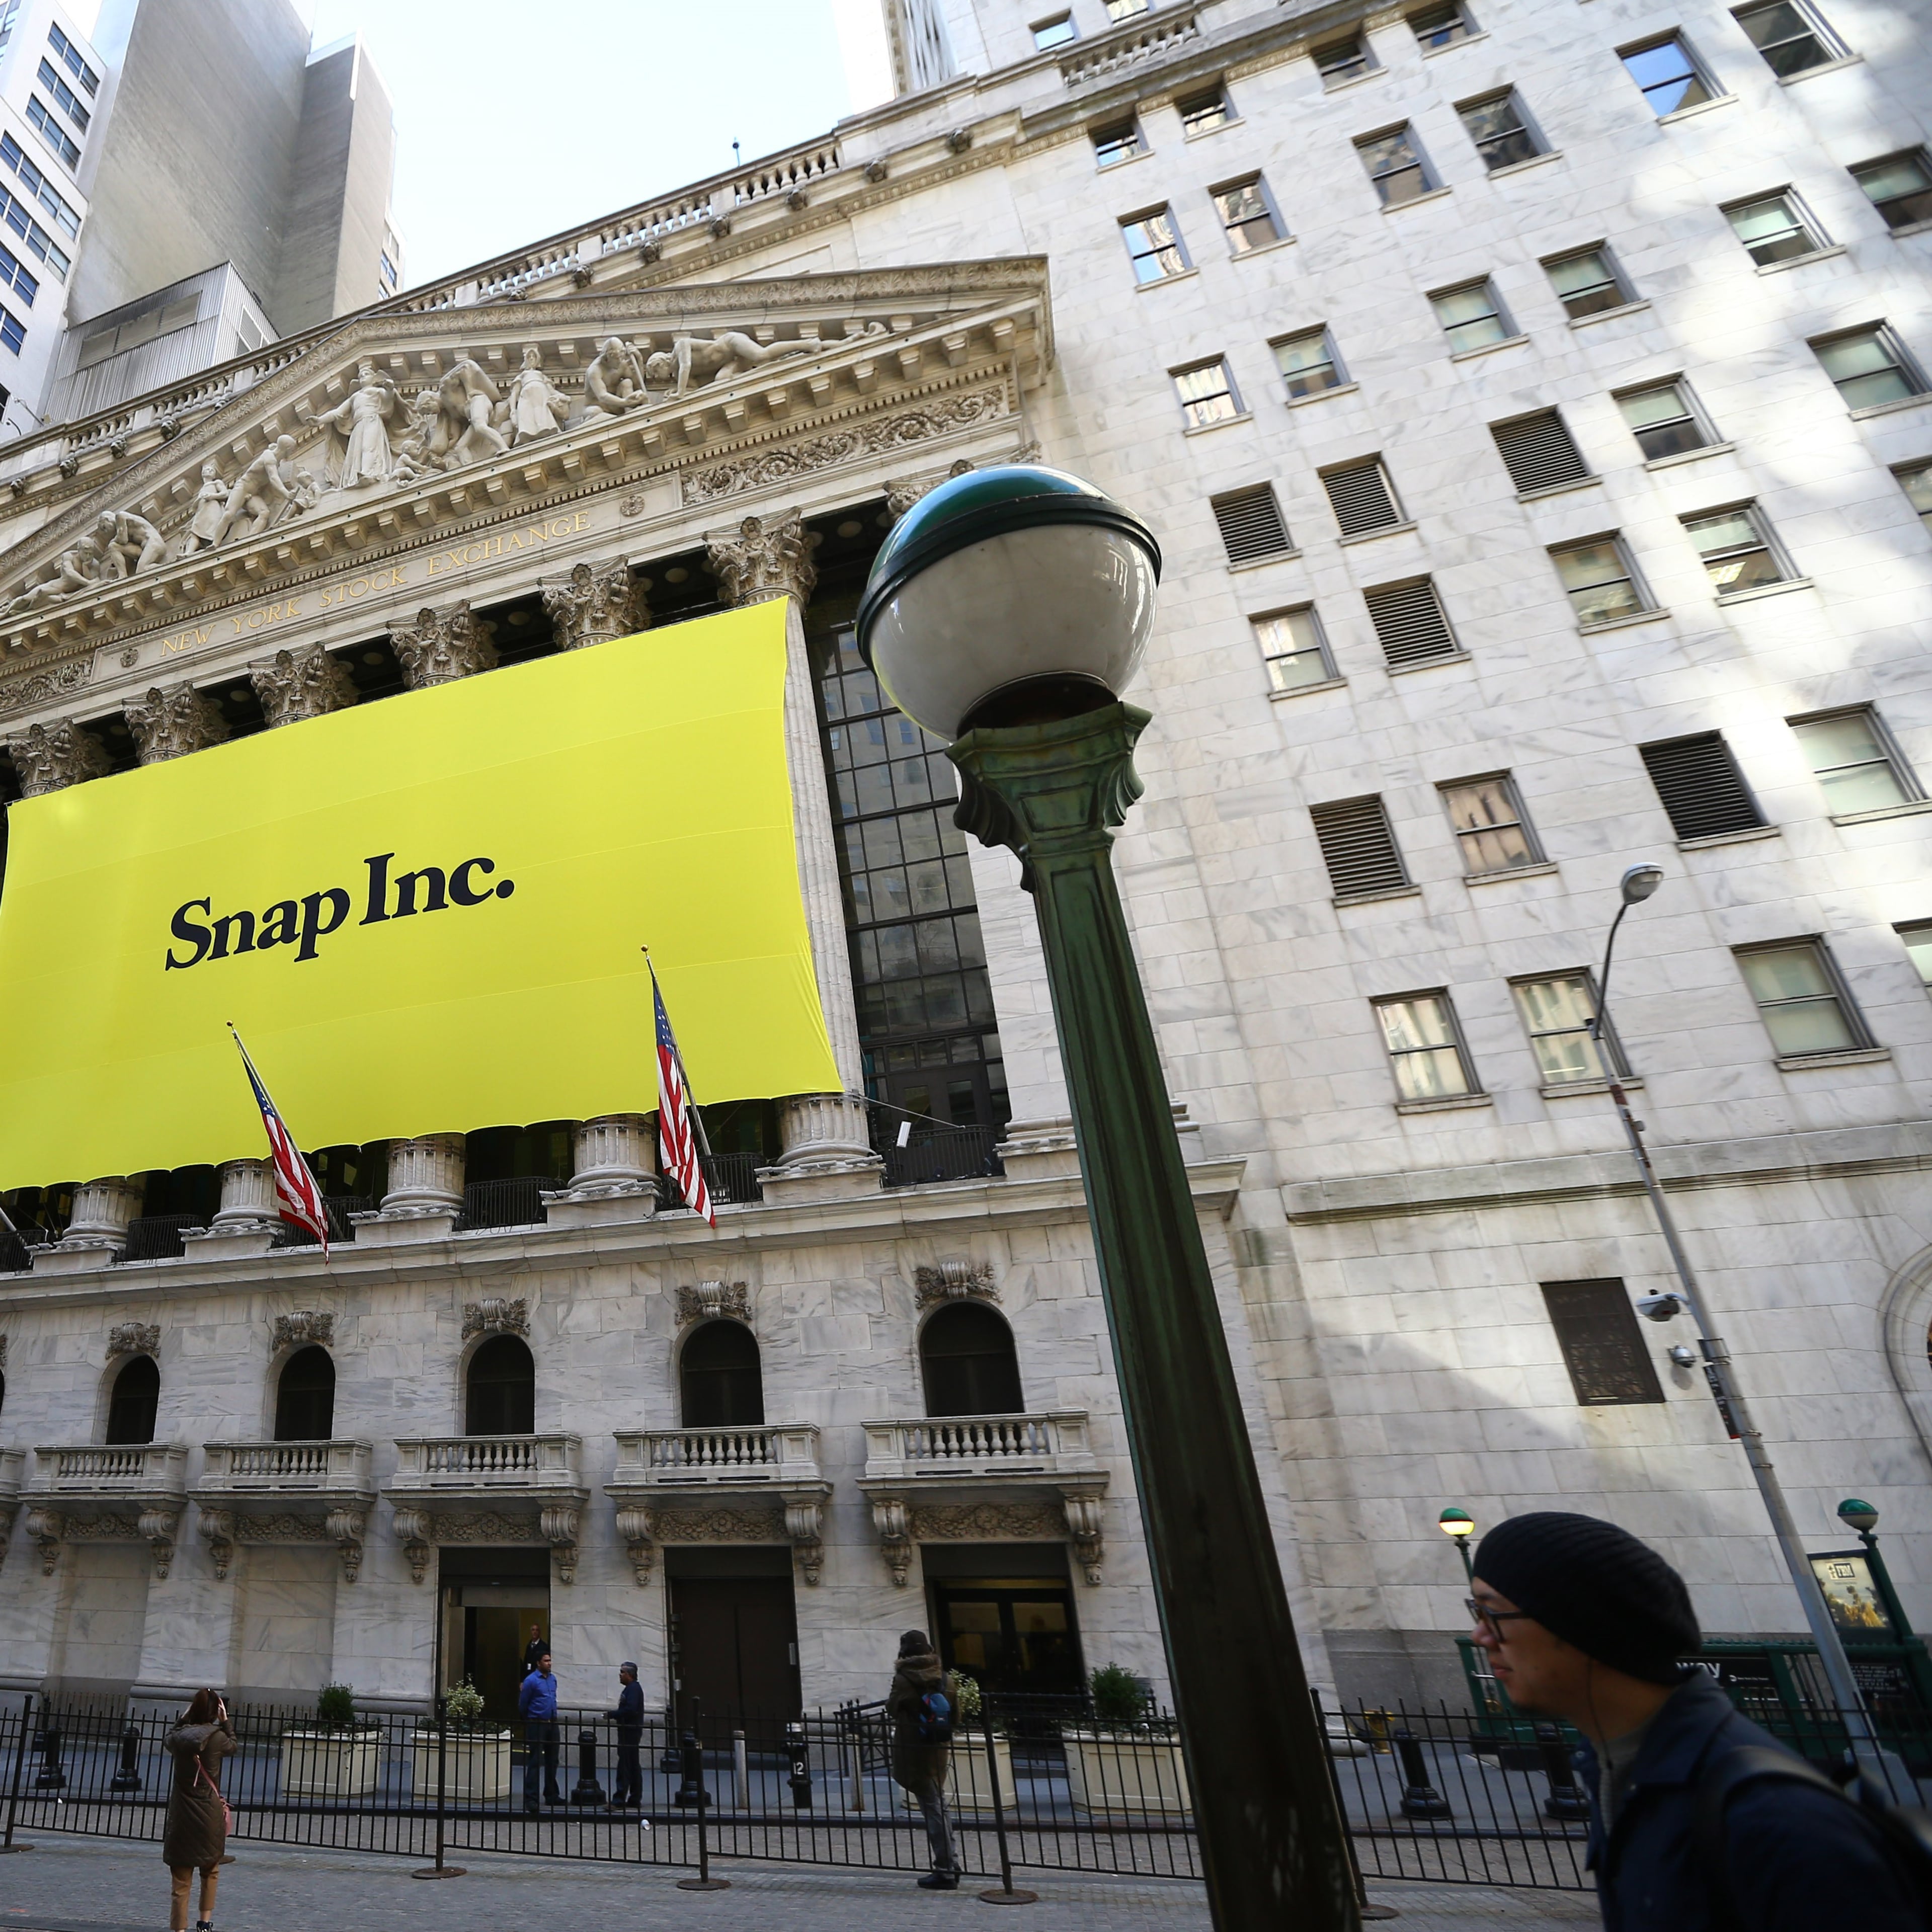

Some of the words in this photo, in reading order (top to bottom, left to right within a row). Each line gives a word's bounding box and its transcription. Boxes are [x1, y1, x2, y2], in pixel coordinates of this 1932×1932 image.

[160, 624, 215, 656] NEW
[231, 597, 302, 633] YORK
[319, 567, 408, 607] STOCK
[427, 511, 591, 575] EXCHANGE
[165, 888, 351, 972] Snap
[358, 852, 515, 926] Inc.
[793, 1762, 804, 1775] 12
